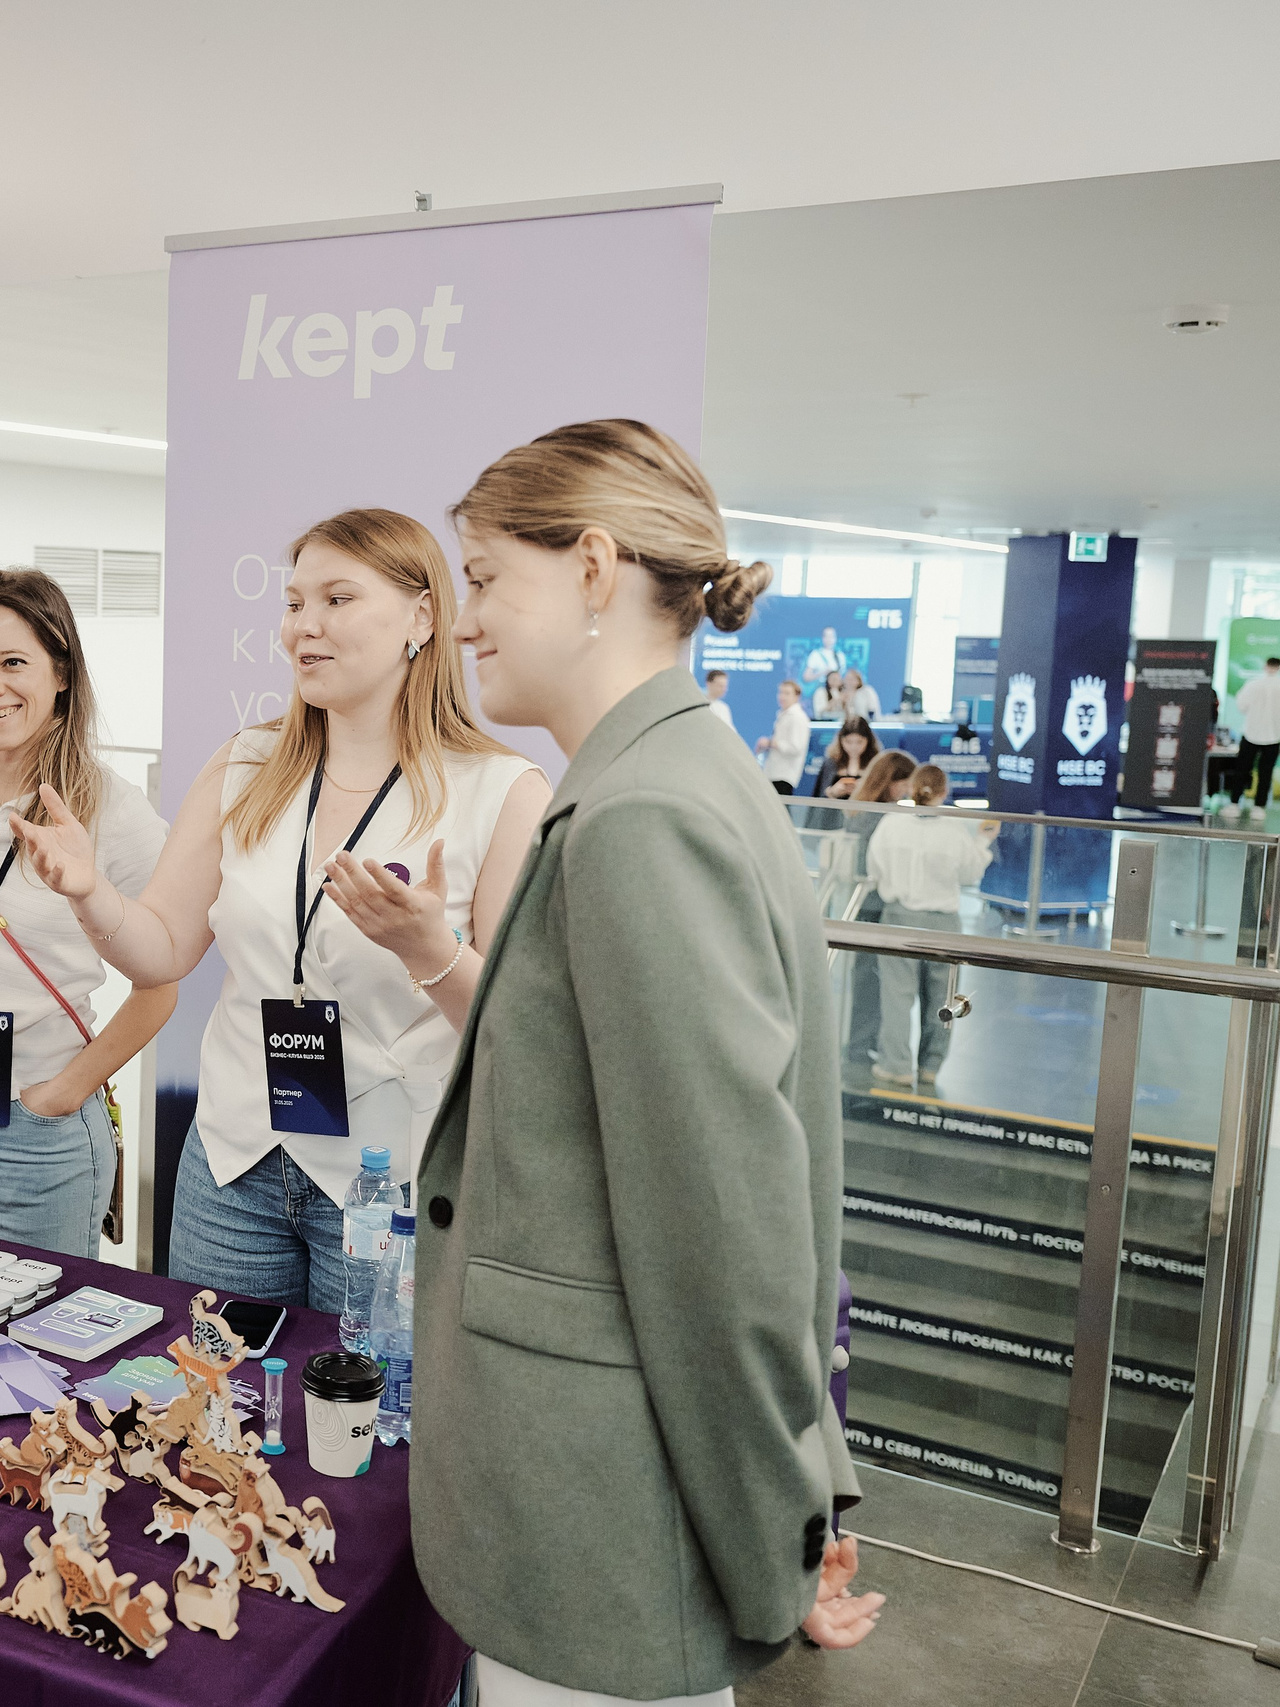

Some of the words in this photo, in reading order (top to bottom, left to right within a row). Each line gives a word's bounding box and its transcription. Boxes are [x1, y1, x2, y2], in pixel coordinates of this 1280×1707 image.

[238, 285, 464, 399] kept
[868, 609, 902, 629] ВТБ
[269, 1033, 325, 1050] ФОРУМ
[273, 1087, 303, 1098] Партнер
[892, 1109, 918, 1125] ВАС
[919, 1114, 942, 1129] НЕТ
[942, 1117, 1005, 1139] ПРИБЫЛИ
[1027, 1132, 1055, 1148] ВАС
[1056, 1137, 1089, 1155] ЕСТЬ
[1152, 1153, 1170, 1167] ЗА
[1173, 1156, 1213, 1174] РИСК
[843, 1196, 981, 1234] ЕДПРИНИМАТЕЛЬСКИЙ
[983, 1223, 1018, 1241] ПУТЬ
[1131, 1252, 1206, 1279] ОБУЧЕНИЕ
[22, 1263, 47, 1271] kept
[18, 1322, 39, 1332] kept
[899, 1318, 950, 1341] ЛЮБЫЕ
[952, 1330, 1031, 1358] ПРОБЛЕМЫ
[1032, 1348, 1063, 1366] КАК
[82, 1392, 101, 1400] kep
[873, 1435, 883, 1449] В
[884, 1439, 921, 1459] СЕБЯ
[923, 1449, 994, 1479] МОЖЕШЬ
[995, 1468, 1058, 1497] ТОЛЬКО
